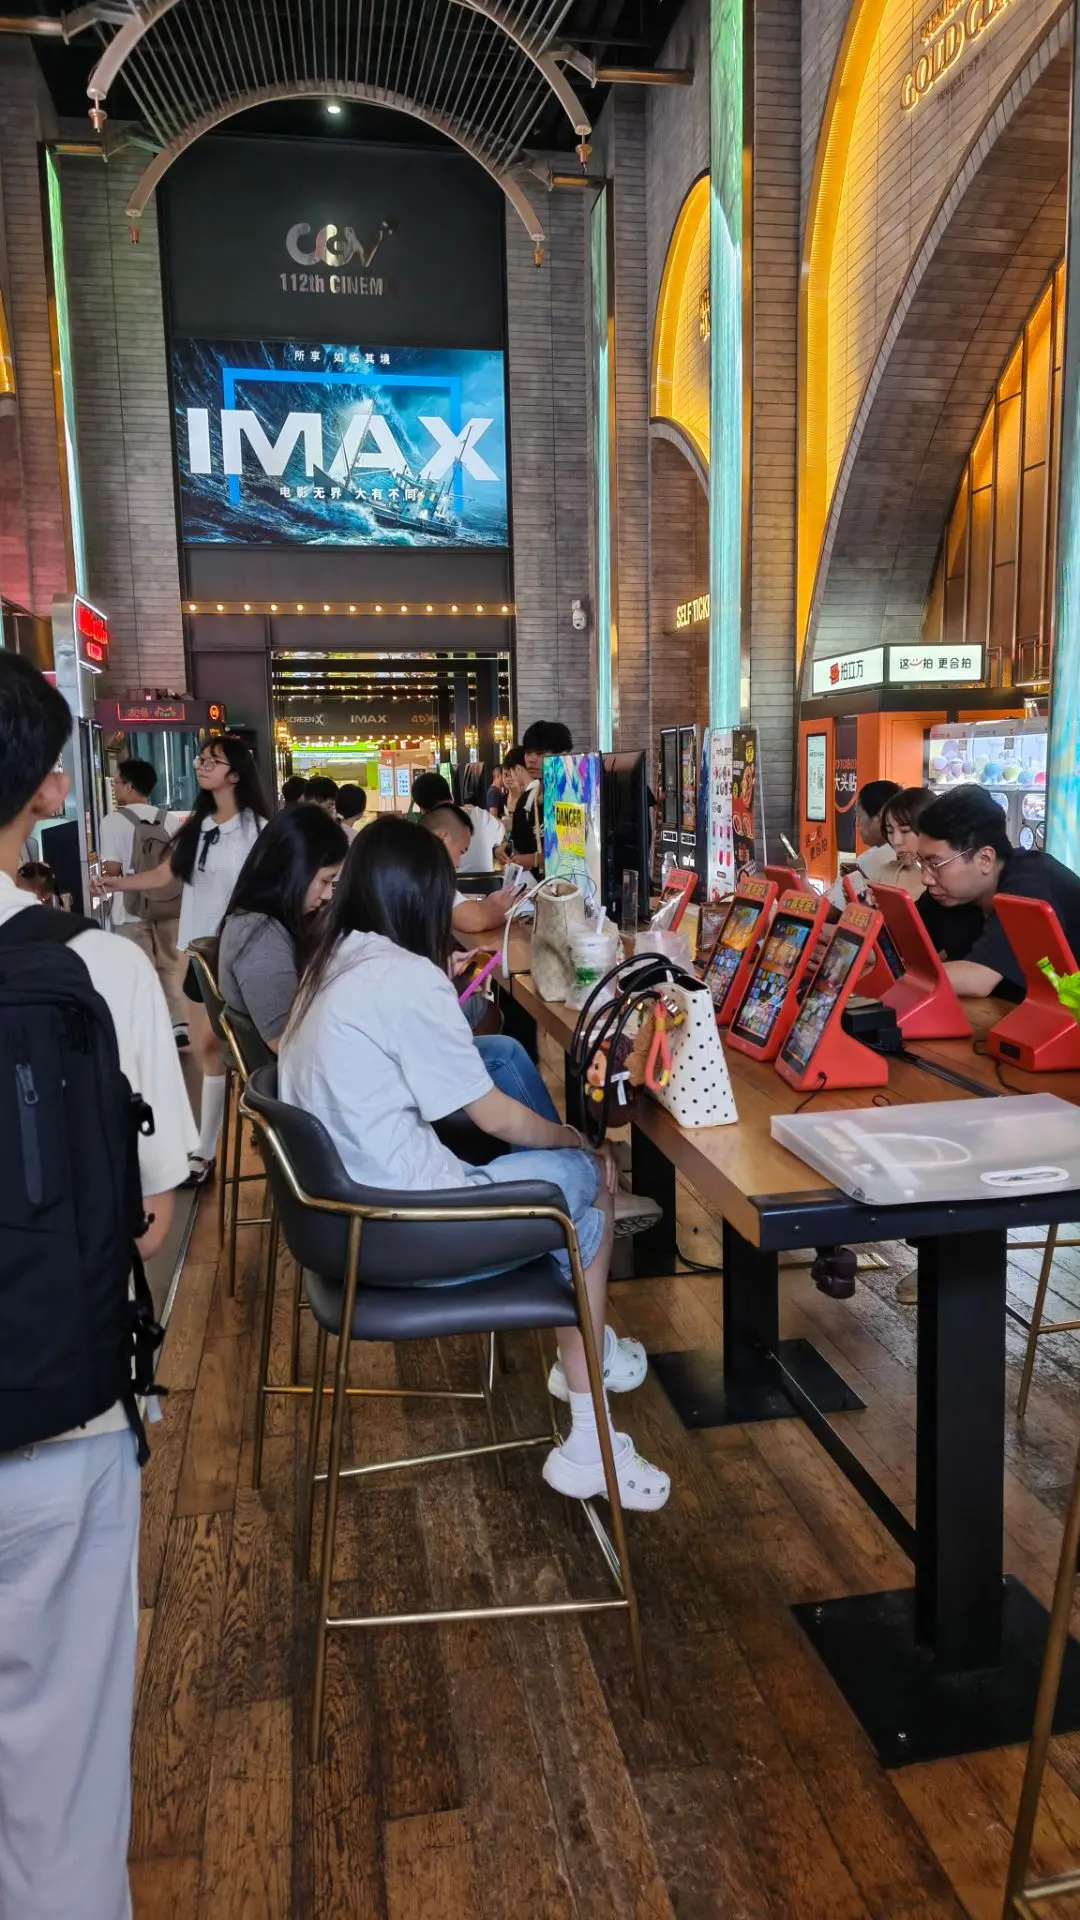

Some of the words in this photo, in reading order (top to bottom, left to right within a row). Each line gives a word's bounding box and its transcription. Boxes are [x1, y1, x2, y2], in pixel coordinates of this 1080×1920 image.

[285, 220, 394, 269] CGV
[279, 272, 325, 293] 112th
[294, 349, 321, 362] 所享
[333, 352, 391, 366] 如临其境
[186, 407, 500, 482] IMAX
[279, 486, 342, 500] 电影无界
[355, 487, 417, 502] 大有不同
[676, 602, 692, 628] SELF
[840, 658, 864, 681] 拍立方
[938, 657, 972, 669] 更合拍
[350, 714, 388, 724] IMAX
[556, 805, 583, 828] DANGER
